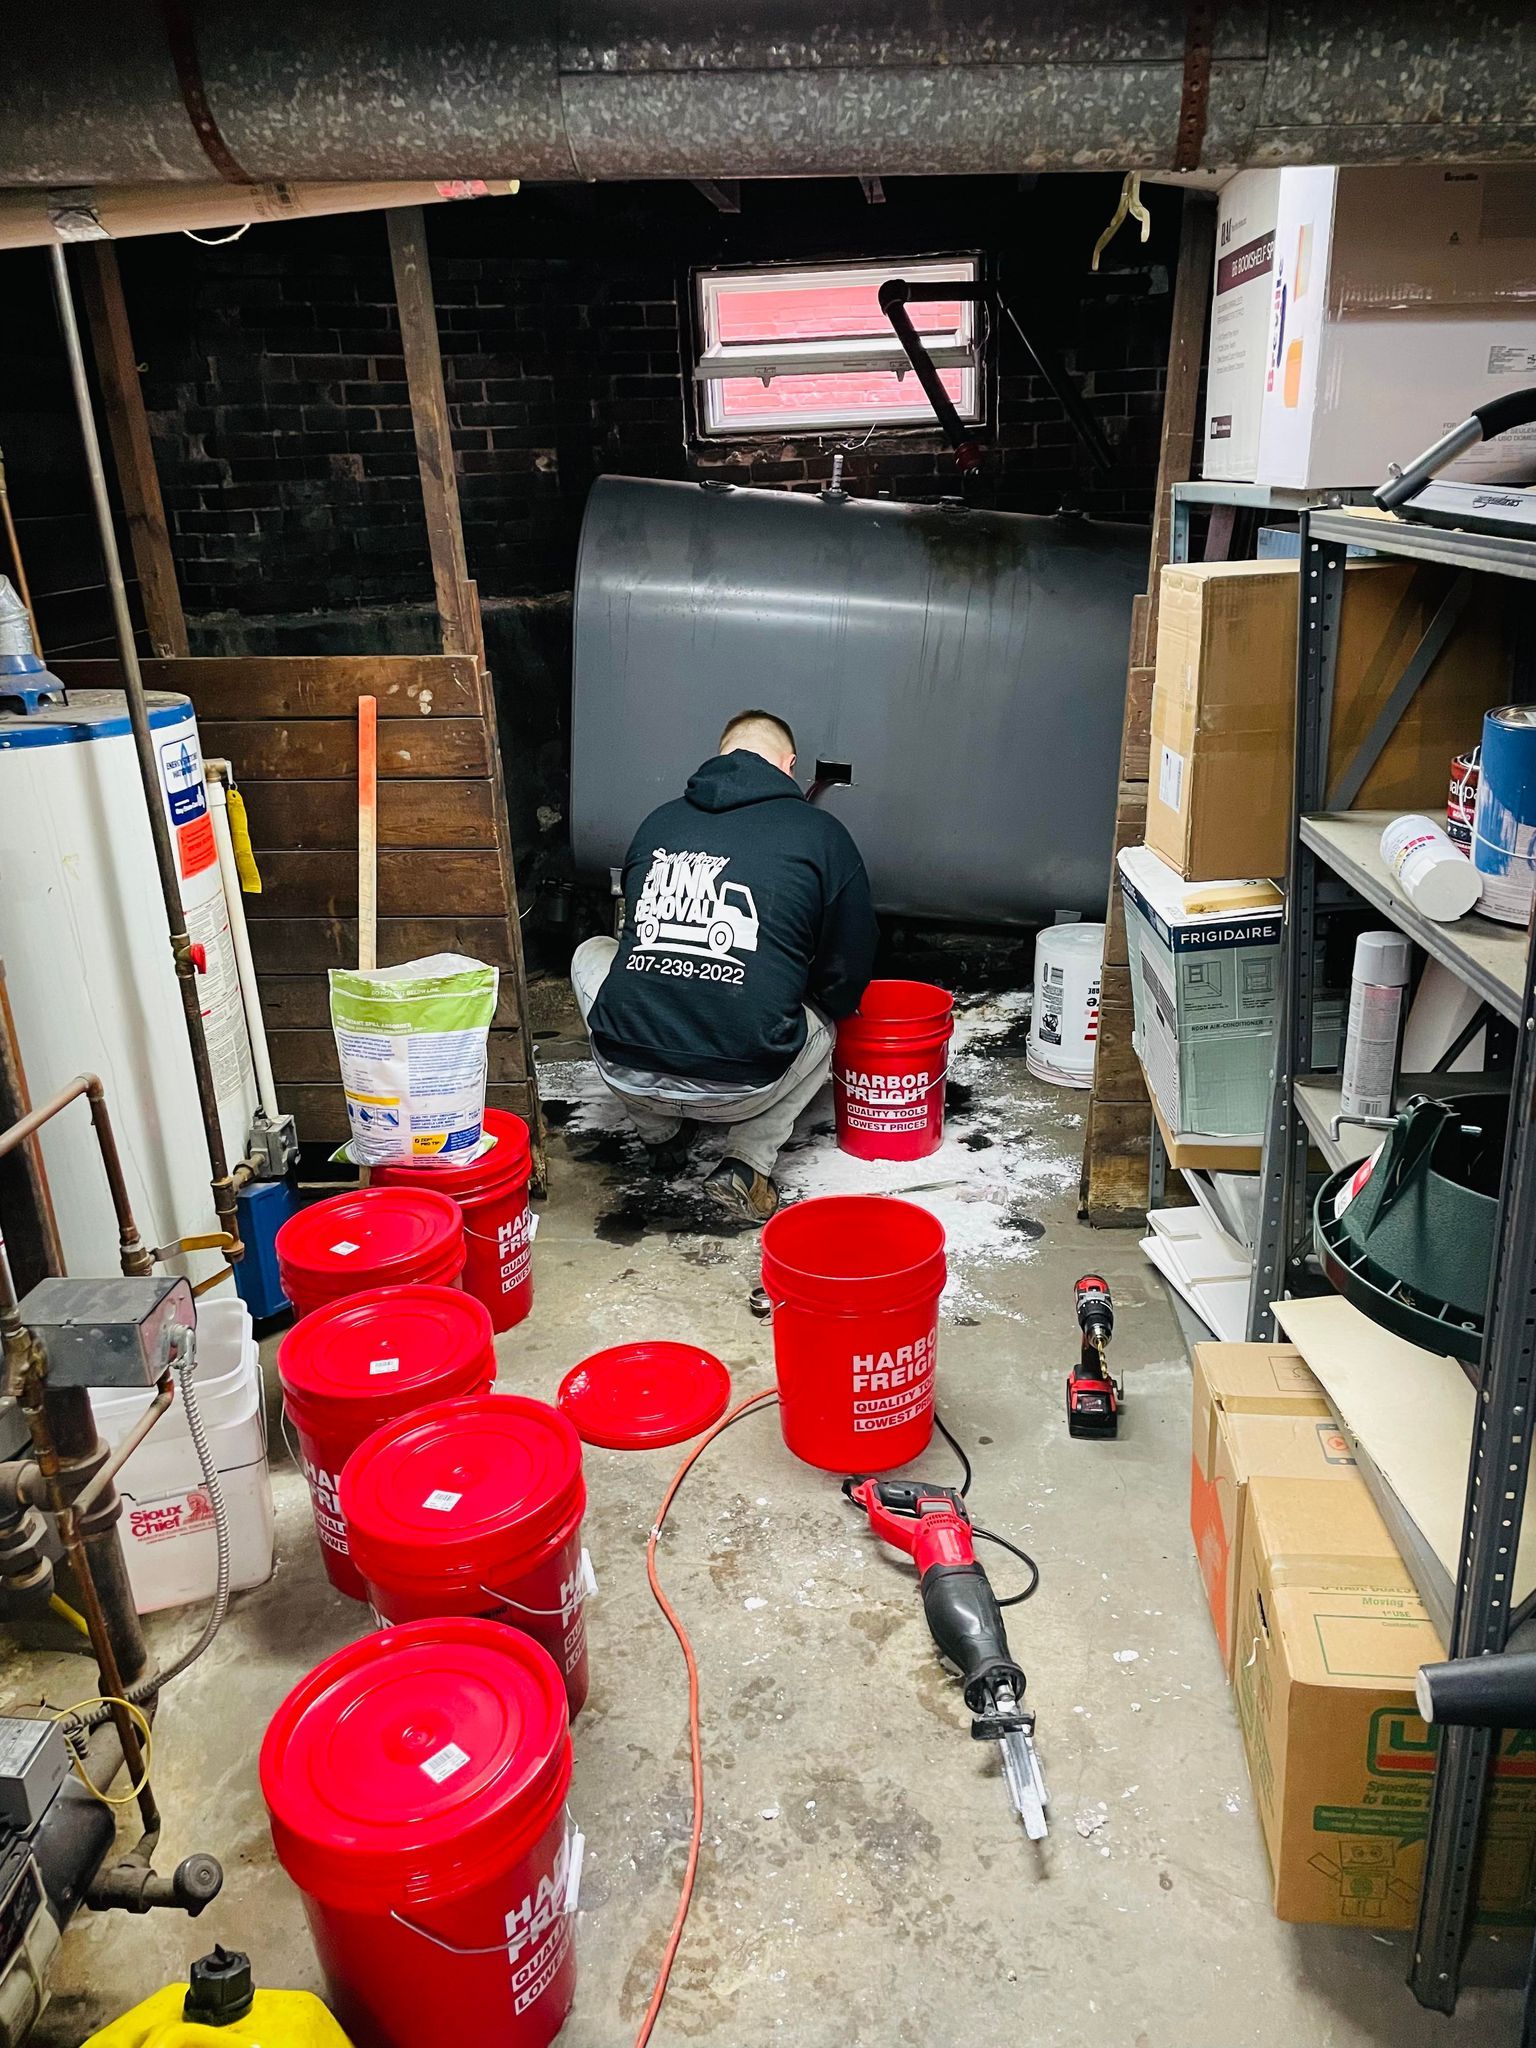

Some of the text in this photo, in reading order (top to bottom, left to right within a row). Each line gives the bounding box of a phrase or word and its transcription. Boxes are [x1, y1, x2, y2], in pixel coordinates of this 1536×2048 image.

[1238, 244, 1267, 275] BOOKSHELF
[642, 862, 723, 902] JUNK
[635, 894, 715, 924] REMOVAL
[626, 954, 745, 985] 207-239-2022
[845, 1069, 929, 1090] HARBOR
[848, 1105, 926, 1118] QUALITY TOOLS
[848, 1117, 926, 1131] LOWEST PRICES
[855, 1387, 917, 1413] QUALITY
[856, 1409, 914, 1431] LOWEST
[129, 1504, 184, 1525] Sioux
[131, 1514, 182, 1538] Chief
[1362, 1596, 1404, 1608] Moving
[1391, 1610, 1412, 1618] USE
